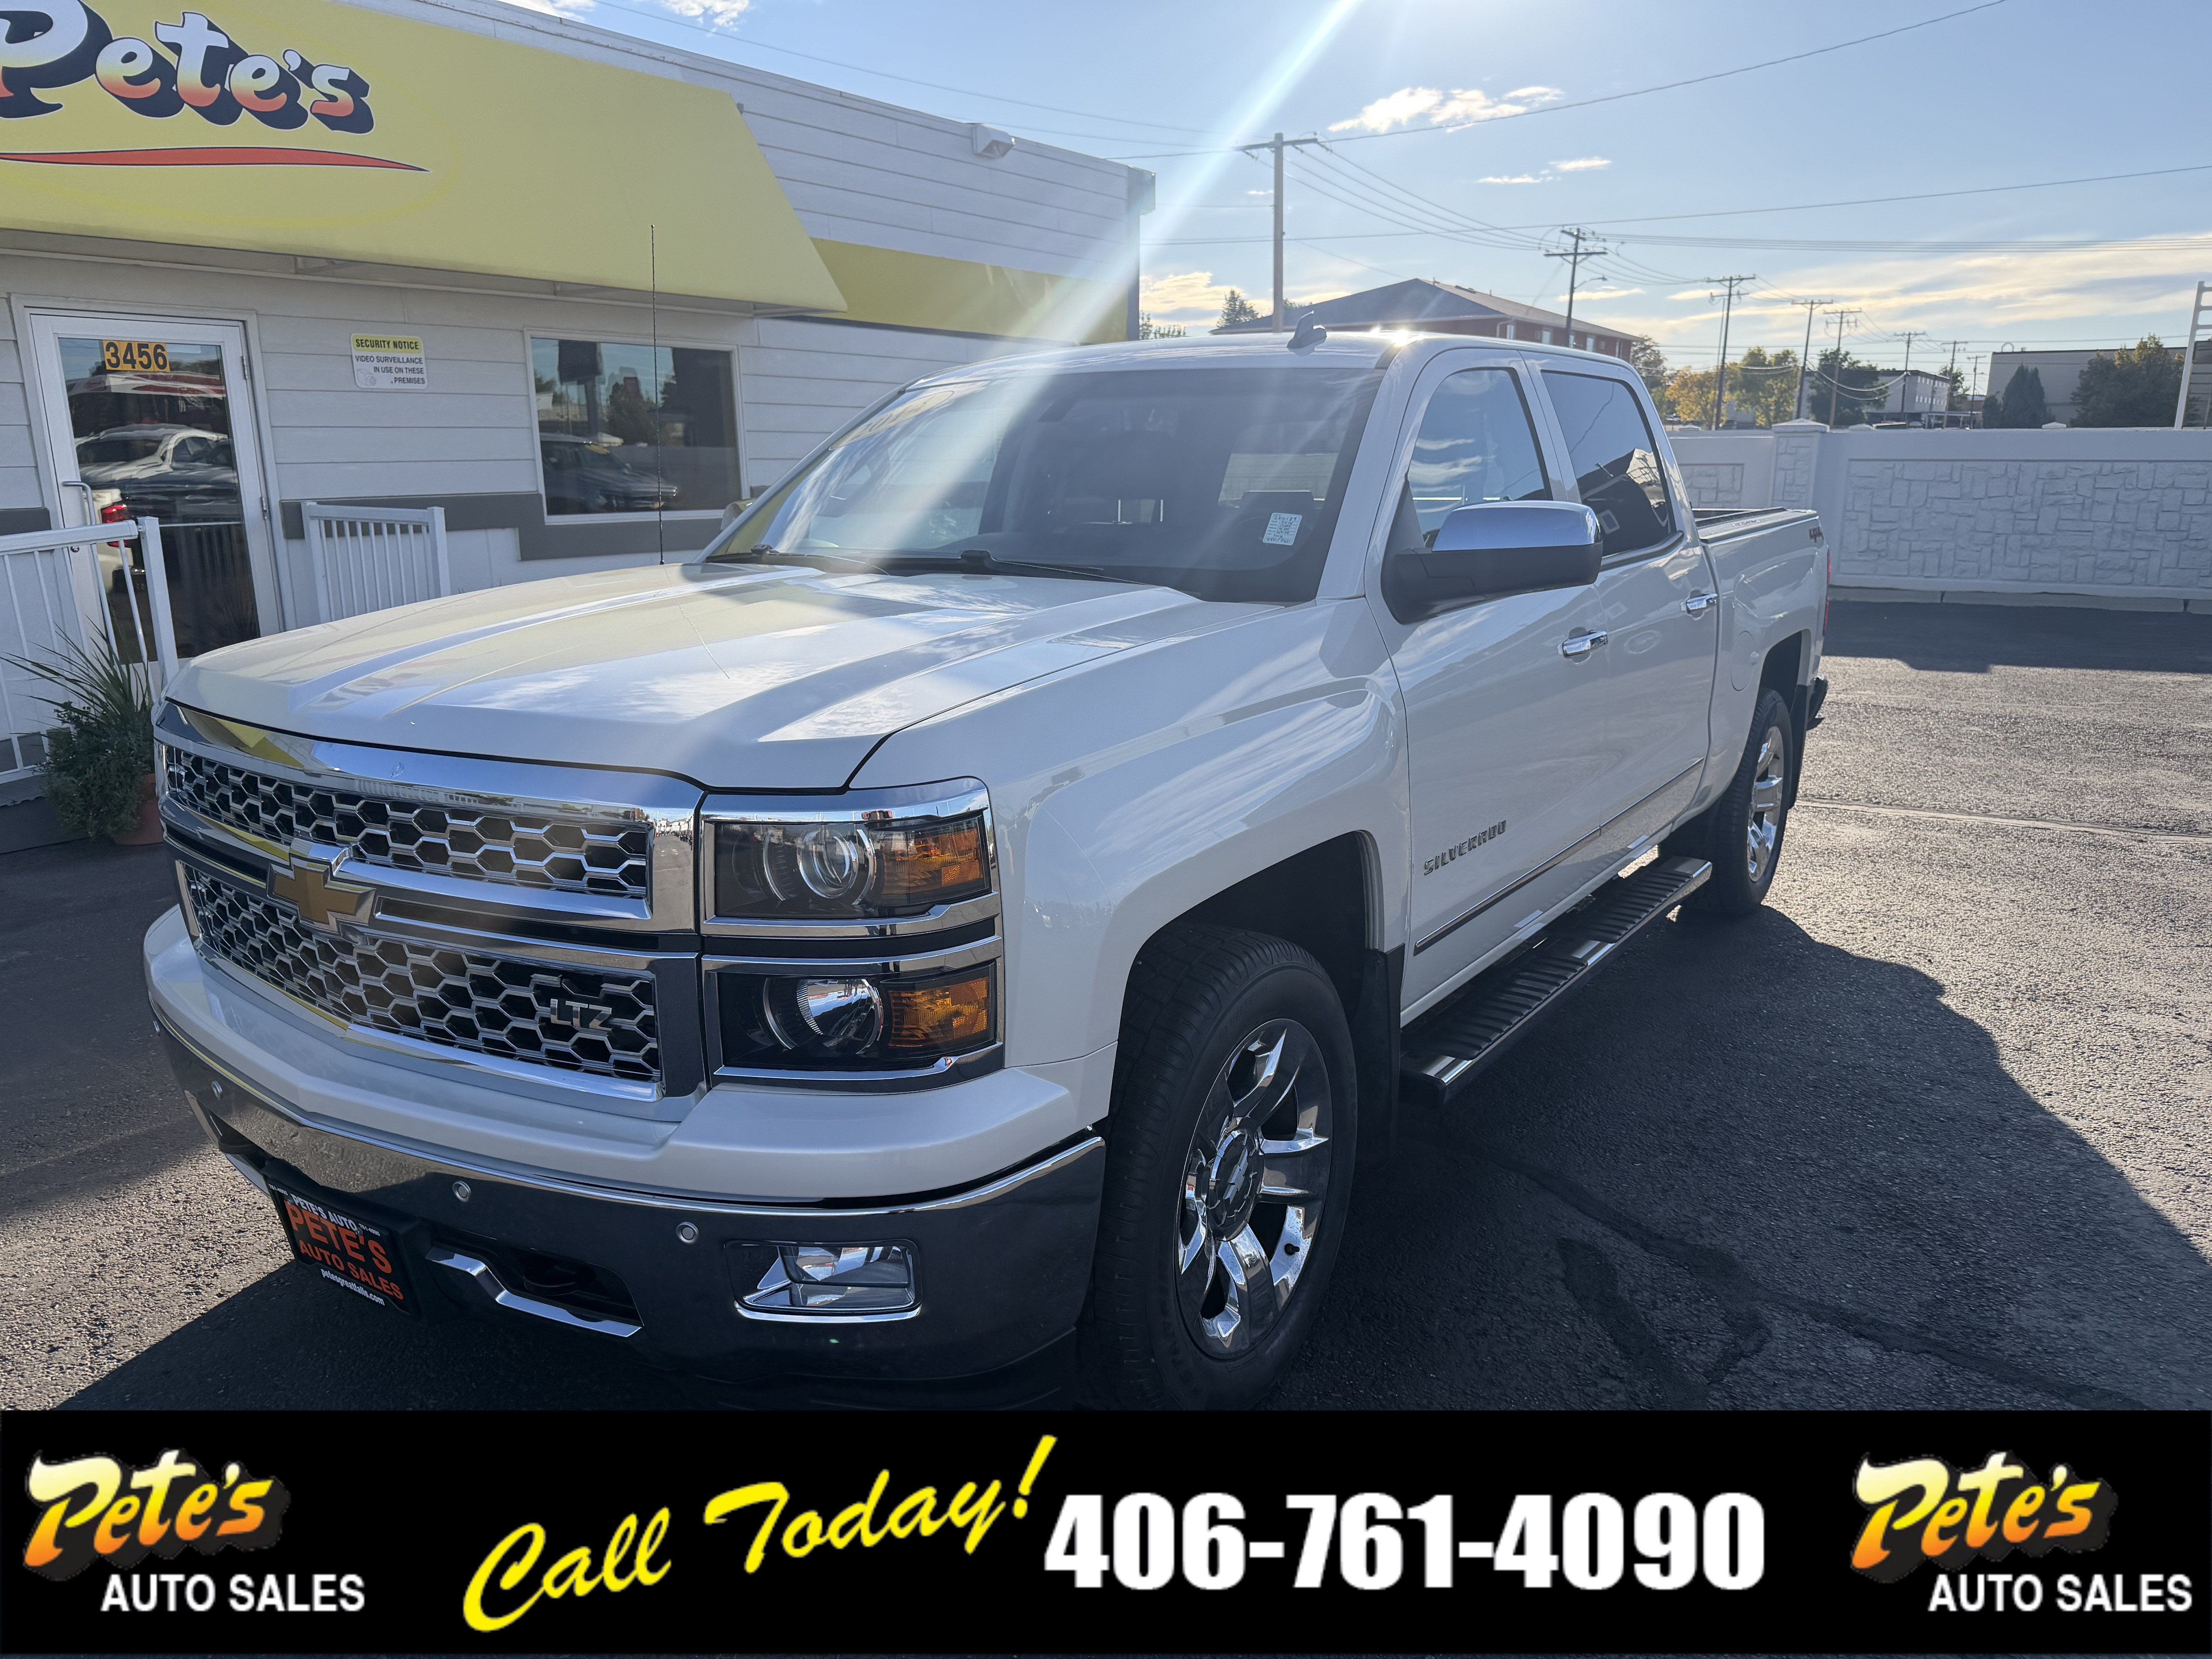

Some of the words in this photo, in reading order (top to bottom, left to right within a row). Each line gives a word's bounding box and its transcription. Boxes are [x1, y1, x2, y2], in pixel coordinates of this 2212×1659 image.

[0, 0, 362, 122] Pete's
[106, 342, 167, 370] 3456
[356, 339, 390, 348] SECURITY
[393, 341, 419, 350] NOTICE
[376, 356, 423, 364] SURVEILLANCE
[1424, 820, 1506, 875] SILVERADO
[550, 998, 613, 1032] LTZ
[291, 1194, 327, 1219] PETE'S
[328, 1211, 357, 1231] AUTO
[284, 1200, 392, 1274] PETE'S
[299, 1240, 345, 1271] AUTO
[347, 1262, 404, 1300] SALES
